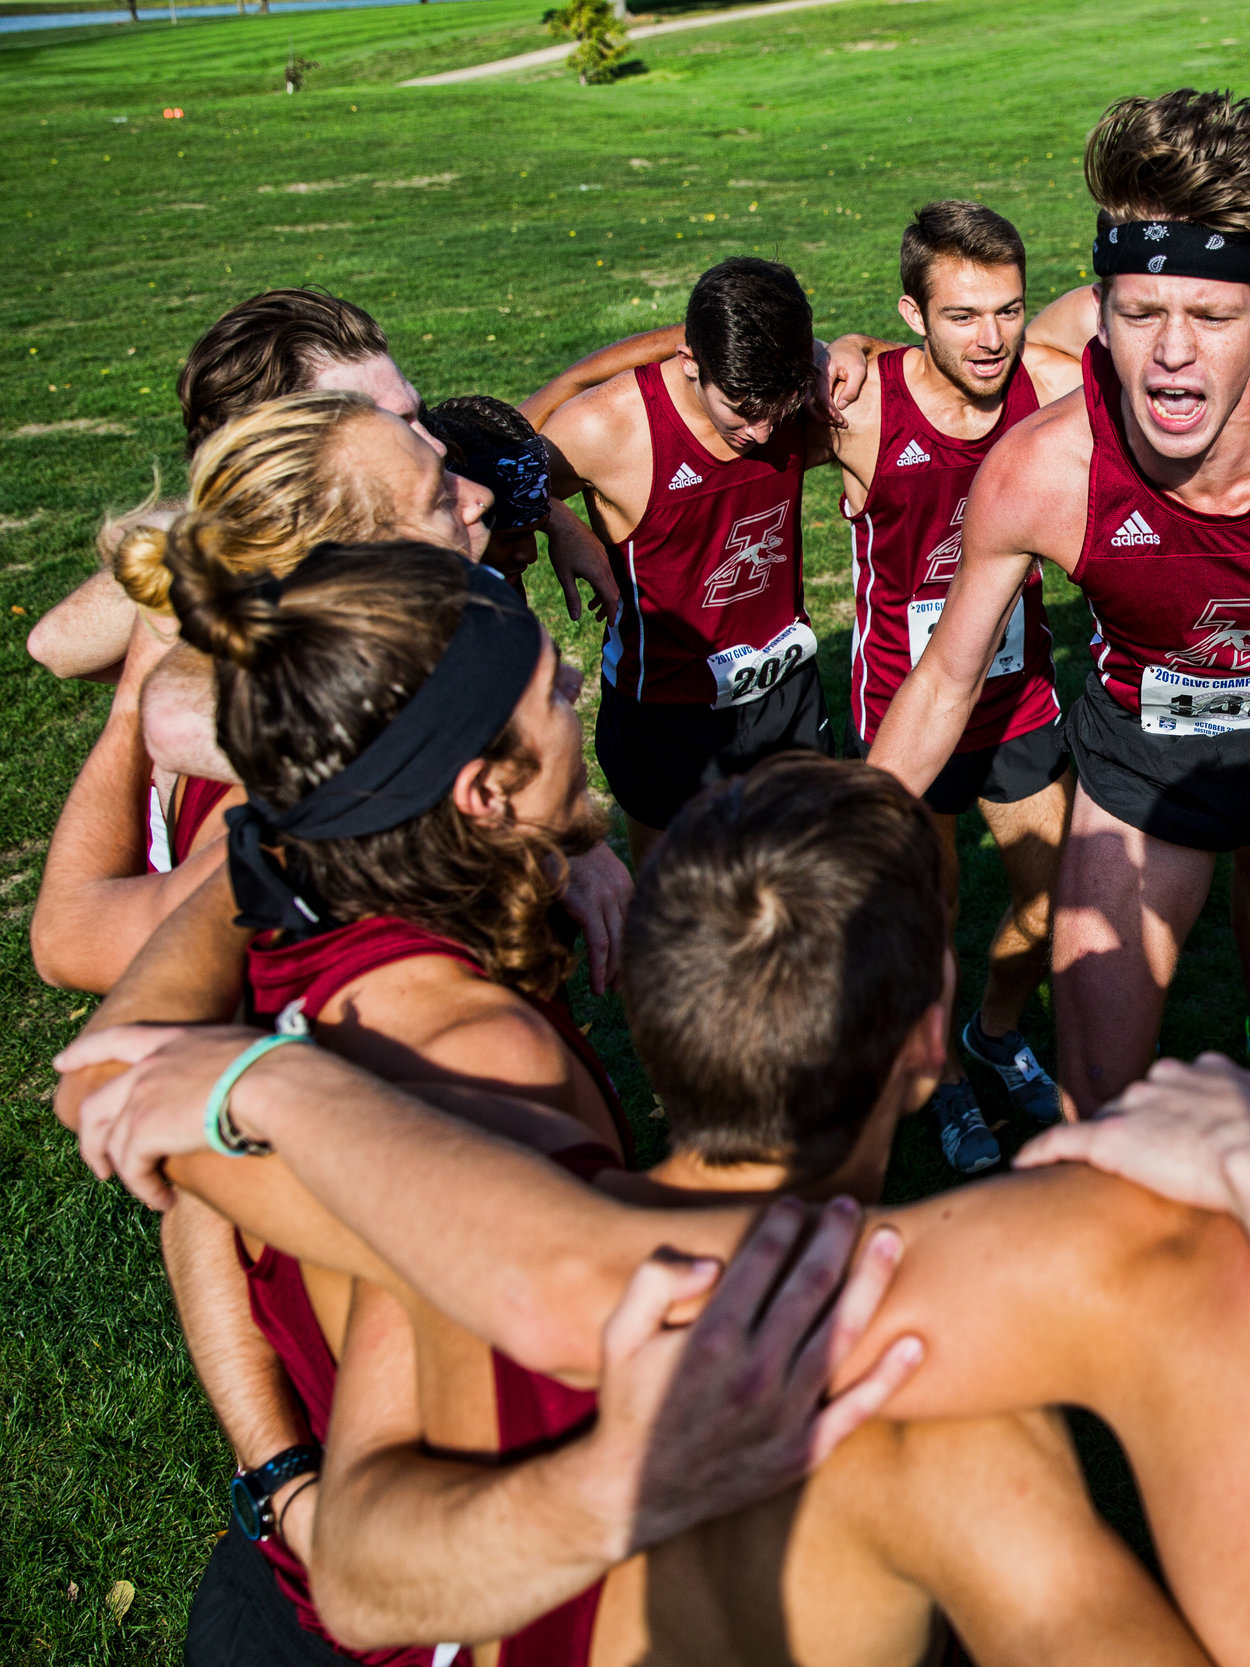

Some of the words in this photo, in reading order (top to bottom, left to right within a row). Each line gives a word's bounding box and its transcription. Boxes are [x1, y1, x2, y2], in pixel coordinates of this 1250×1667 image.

[896, 452, 931, 467] adidas
[668, 474, 703, 491] adidas
[1111, 532, 1160, 547] adidas
[916, 602, 933, 613] 2017
[714, 651, 733, 665] 2017
[733, 645, 753, 659] GLVC
[731, 644, 803, 702] 202
[1154, 668, 1180, 685] 2017
[1182, 677, 1210, 689] GLVC
[1194, 721, 1225, 732] OCTOBER
